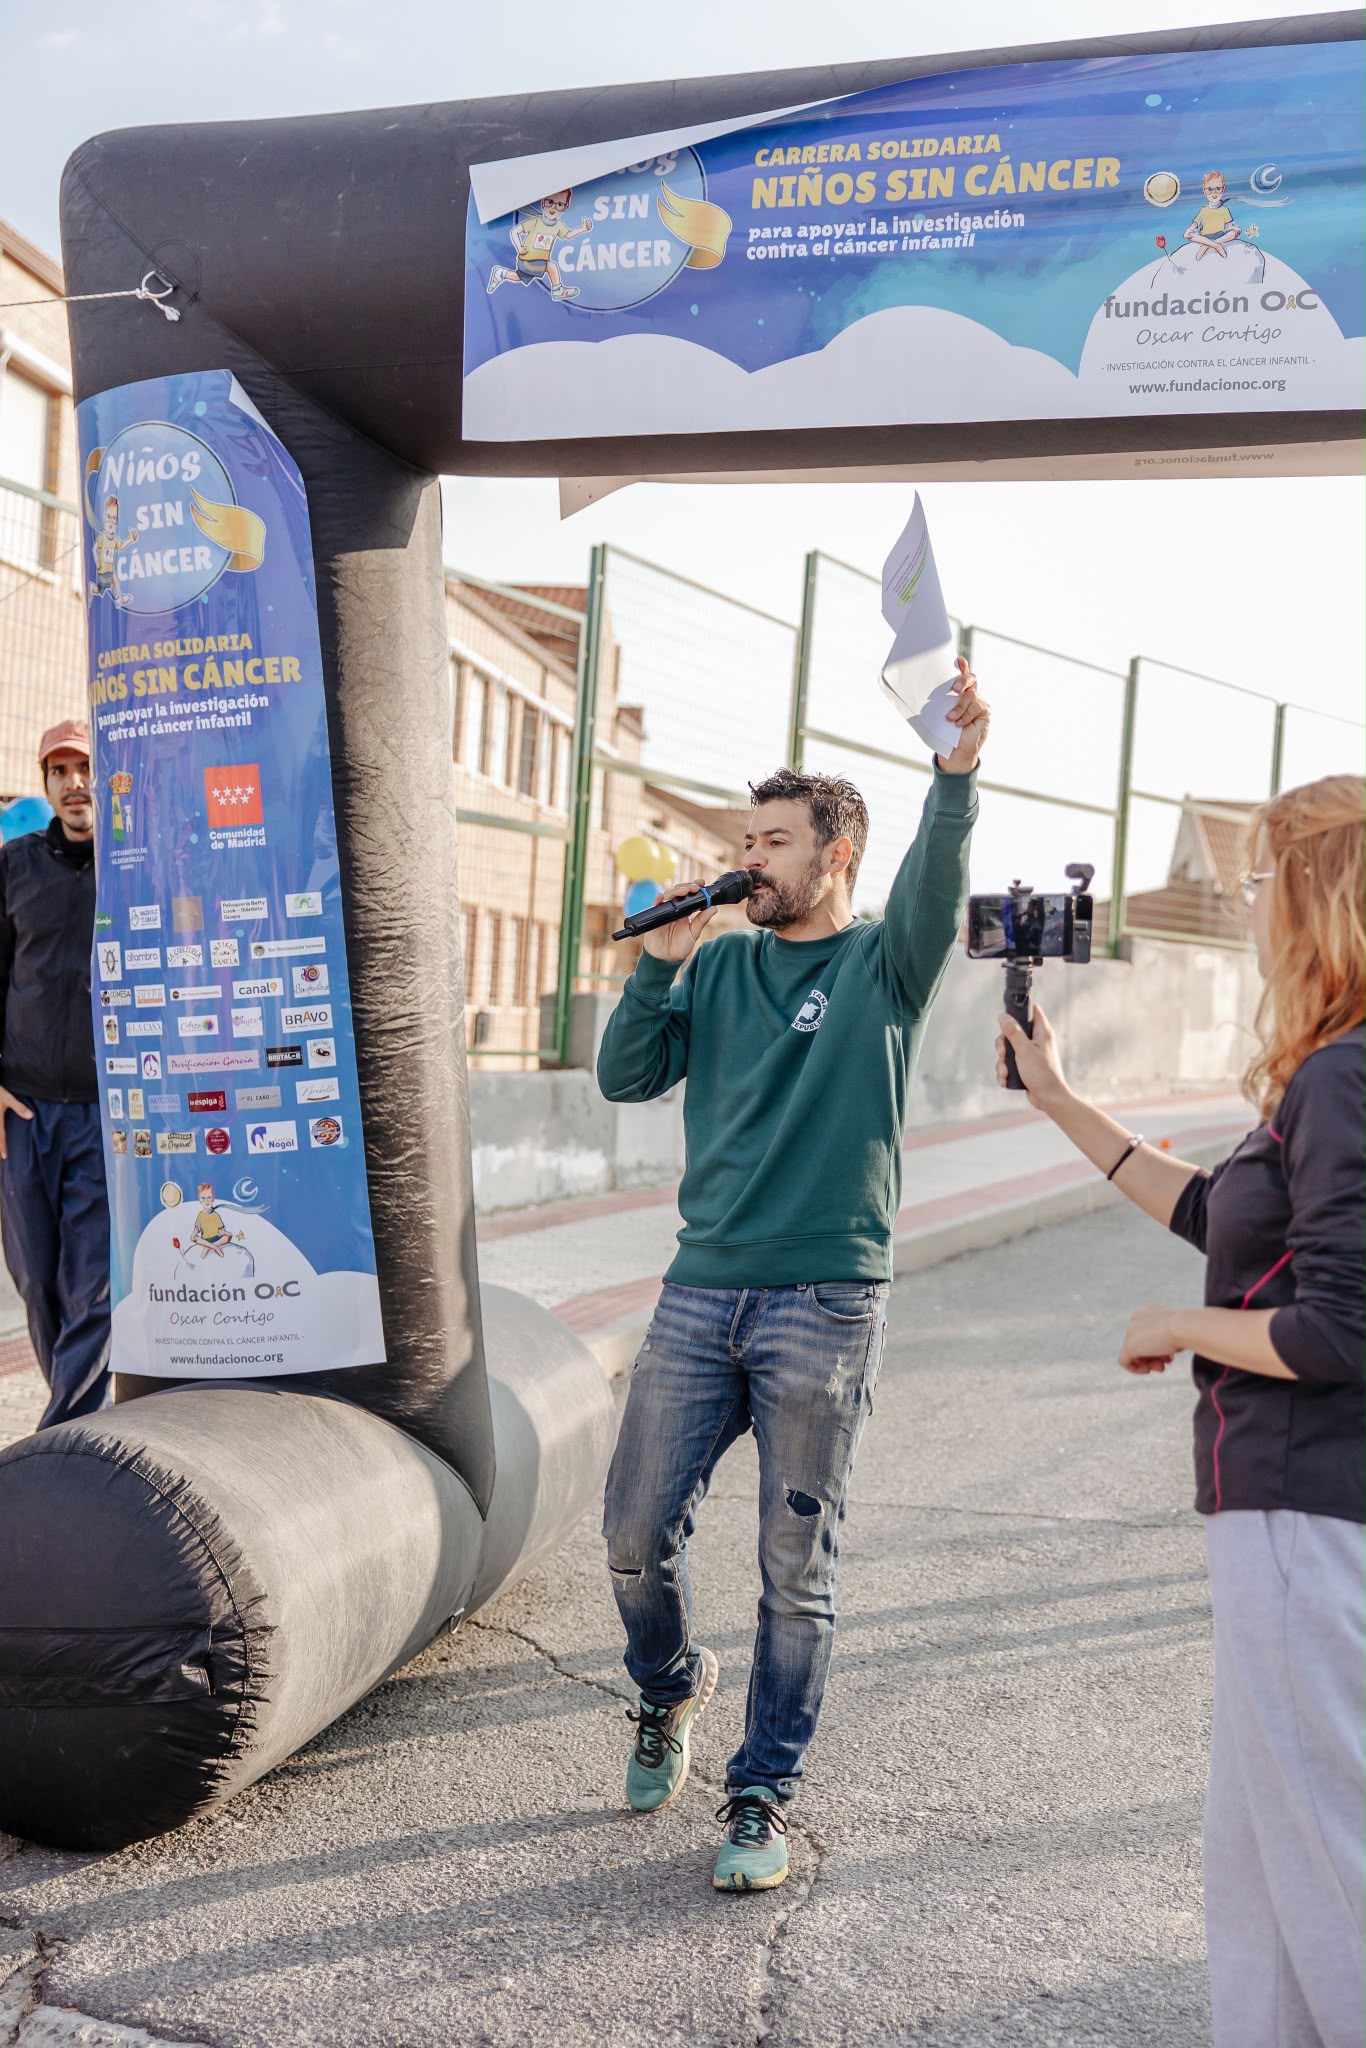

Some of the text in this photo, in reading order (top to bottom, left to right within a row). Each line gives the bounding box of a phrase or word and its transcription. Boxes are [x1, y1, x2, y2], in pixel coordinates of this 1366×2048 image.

[755, 134, 1001, 167] CARRERA SOLIDARIA
[751, 155, 1121, 209] NIÑOS SIN CÁNCER
[593, 194, 649, 222] SIN
[749, 210, 1025, 242] para apoyar la investigación
[558, 240, 672, 272] CÁNCER
[746, 233, 975, 260] contra el cáncer infantil
[1104, 291, 1249, 318] fundación
[1136, 326, 1282, 346] Oscar Contigo
[1106, 356, 1310, 372] INVESTIGACIÓN CONTRA EL CÁNCER INFANTIL
[1129, 378, 1286, 394] www.fundacionoc.org
[103, 446, 201, 493] Niños
[136, 501, 184, 530] SIN
[117, 546, 213, 581] CÁNCER
[154, 633, 253, 658] SOLIDARIA
[133, 666, 178, 698] SIN
[183, 656, 302, 691] CÁNCER
[116, 704, 152, 726] poyar
[155, 703, 168, 717] la
[170, 694, 269, 716] investigación
[138, 722, 148, 737] el
[150, 718, 193, 735] cáncer
[195, 712, 252, 730] infantil
[209, 827, 265, 839] Comunidad
[211, 837, 266, 850] de Madrid
[213, 958, 238, 966] CANELA
[285, 1011, 328, 1025] BRAVO
[171, 1057, 253, 1070] Purificación García
[195, 1098, 217, 1107] espiga
[269, 1139, 294, 1150] Nogal
[149, 1284, 246, 1303] fundación
[170, 1311, 274, 1325] Oscar Contigo
[236, 1335, 266, 1345] CÁNCER
[267, 1333, 300, 1343] INFANTIL
[170, 1351, 284, 1366] www.fundacionoc.org
